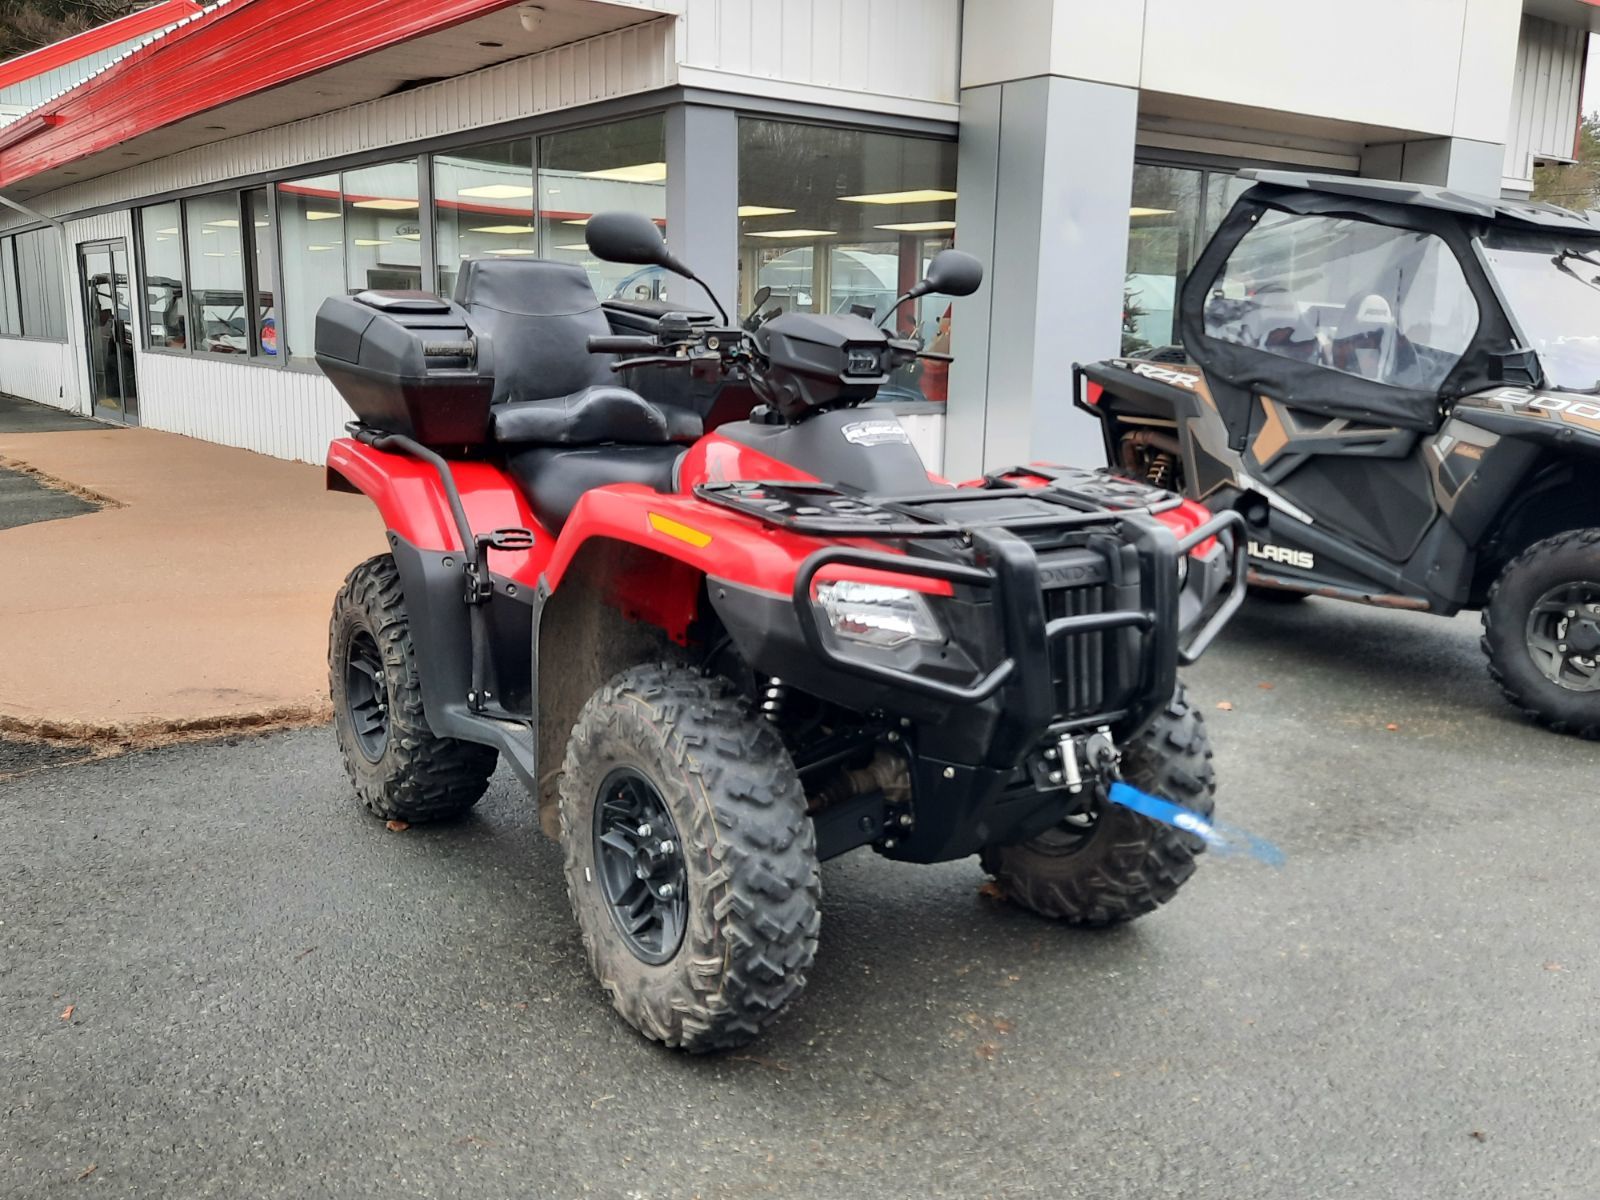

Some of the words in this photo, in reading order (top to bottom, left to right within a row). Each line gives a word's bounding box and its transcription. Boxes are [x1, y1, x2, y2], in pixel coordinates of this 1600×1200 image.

[1132, 363, 1200, 389] RZR
[1247, 541, 1314, 569] LARIS
[1039, 564, 1102, 583] ONDA
